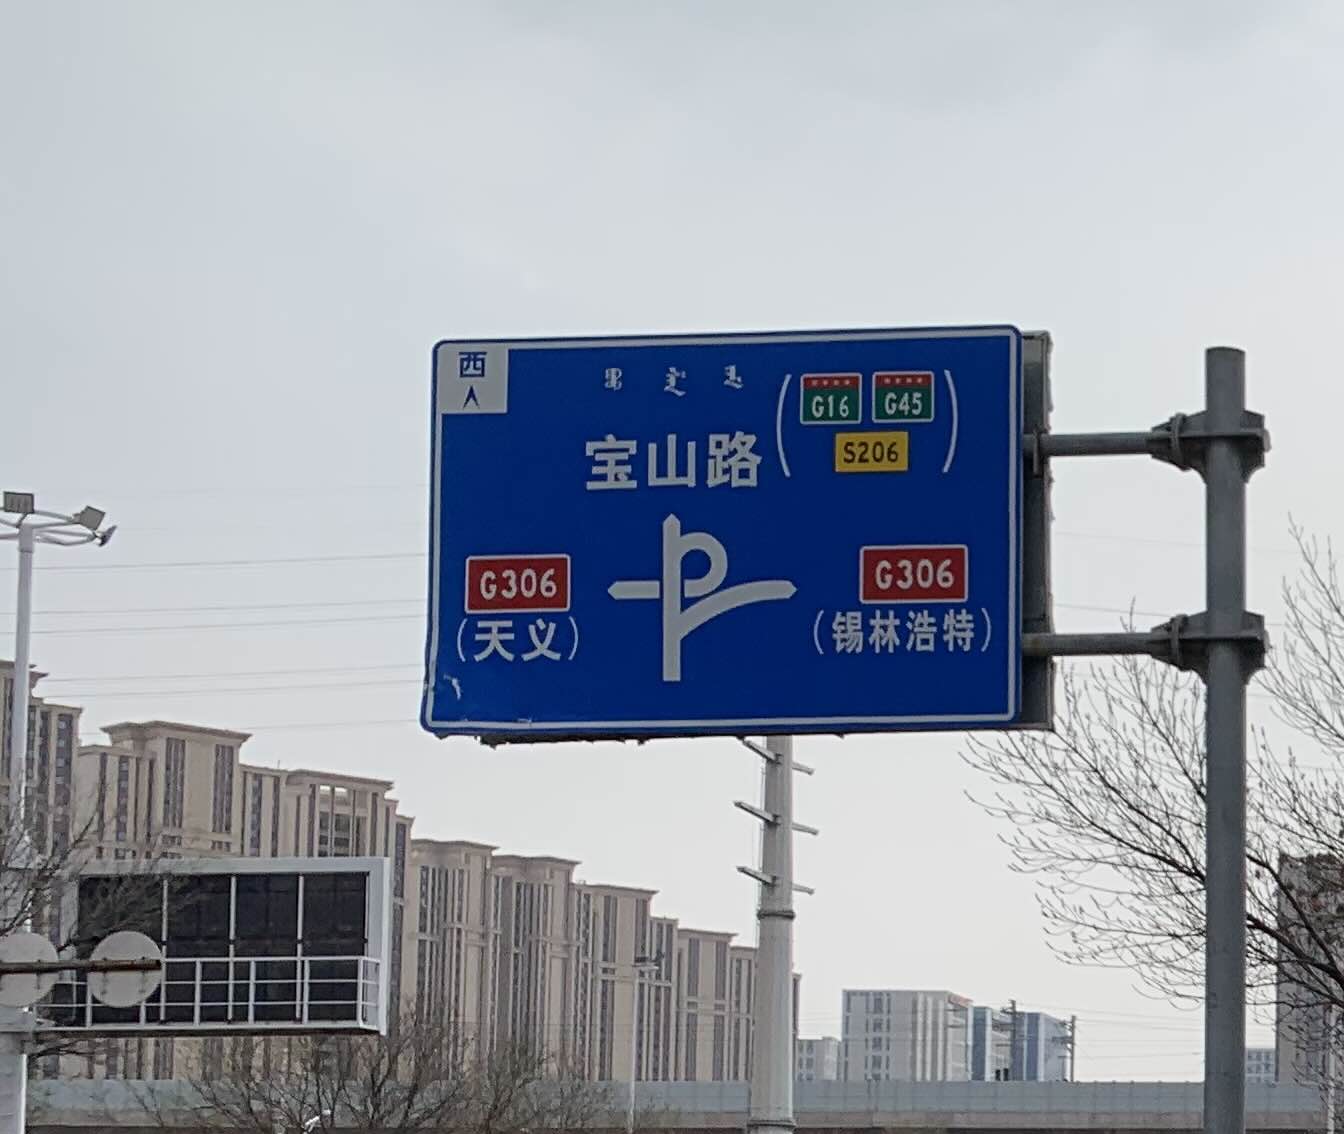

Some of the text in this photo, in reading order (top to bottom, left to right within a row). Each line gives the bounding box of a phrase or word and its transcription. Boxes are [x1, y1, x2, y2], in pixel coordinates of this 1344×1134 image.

[458, 351, 487, 377] 西
[811, 392, 922, 418] G16 G45
[585, 431, 762, 490] 宝山路
[843, 441, 899, 464] S206
[480, 567, 557, 600] G306
[875, 558, 954, 590] G306
